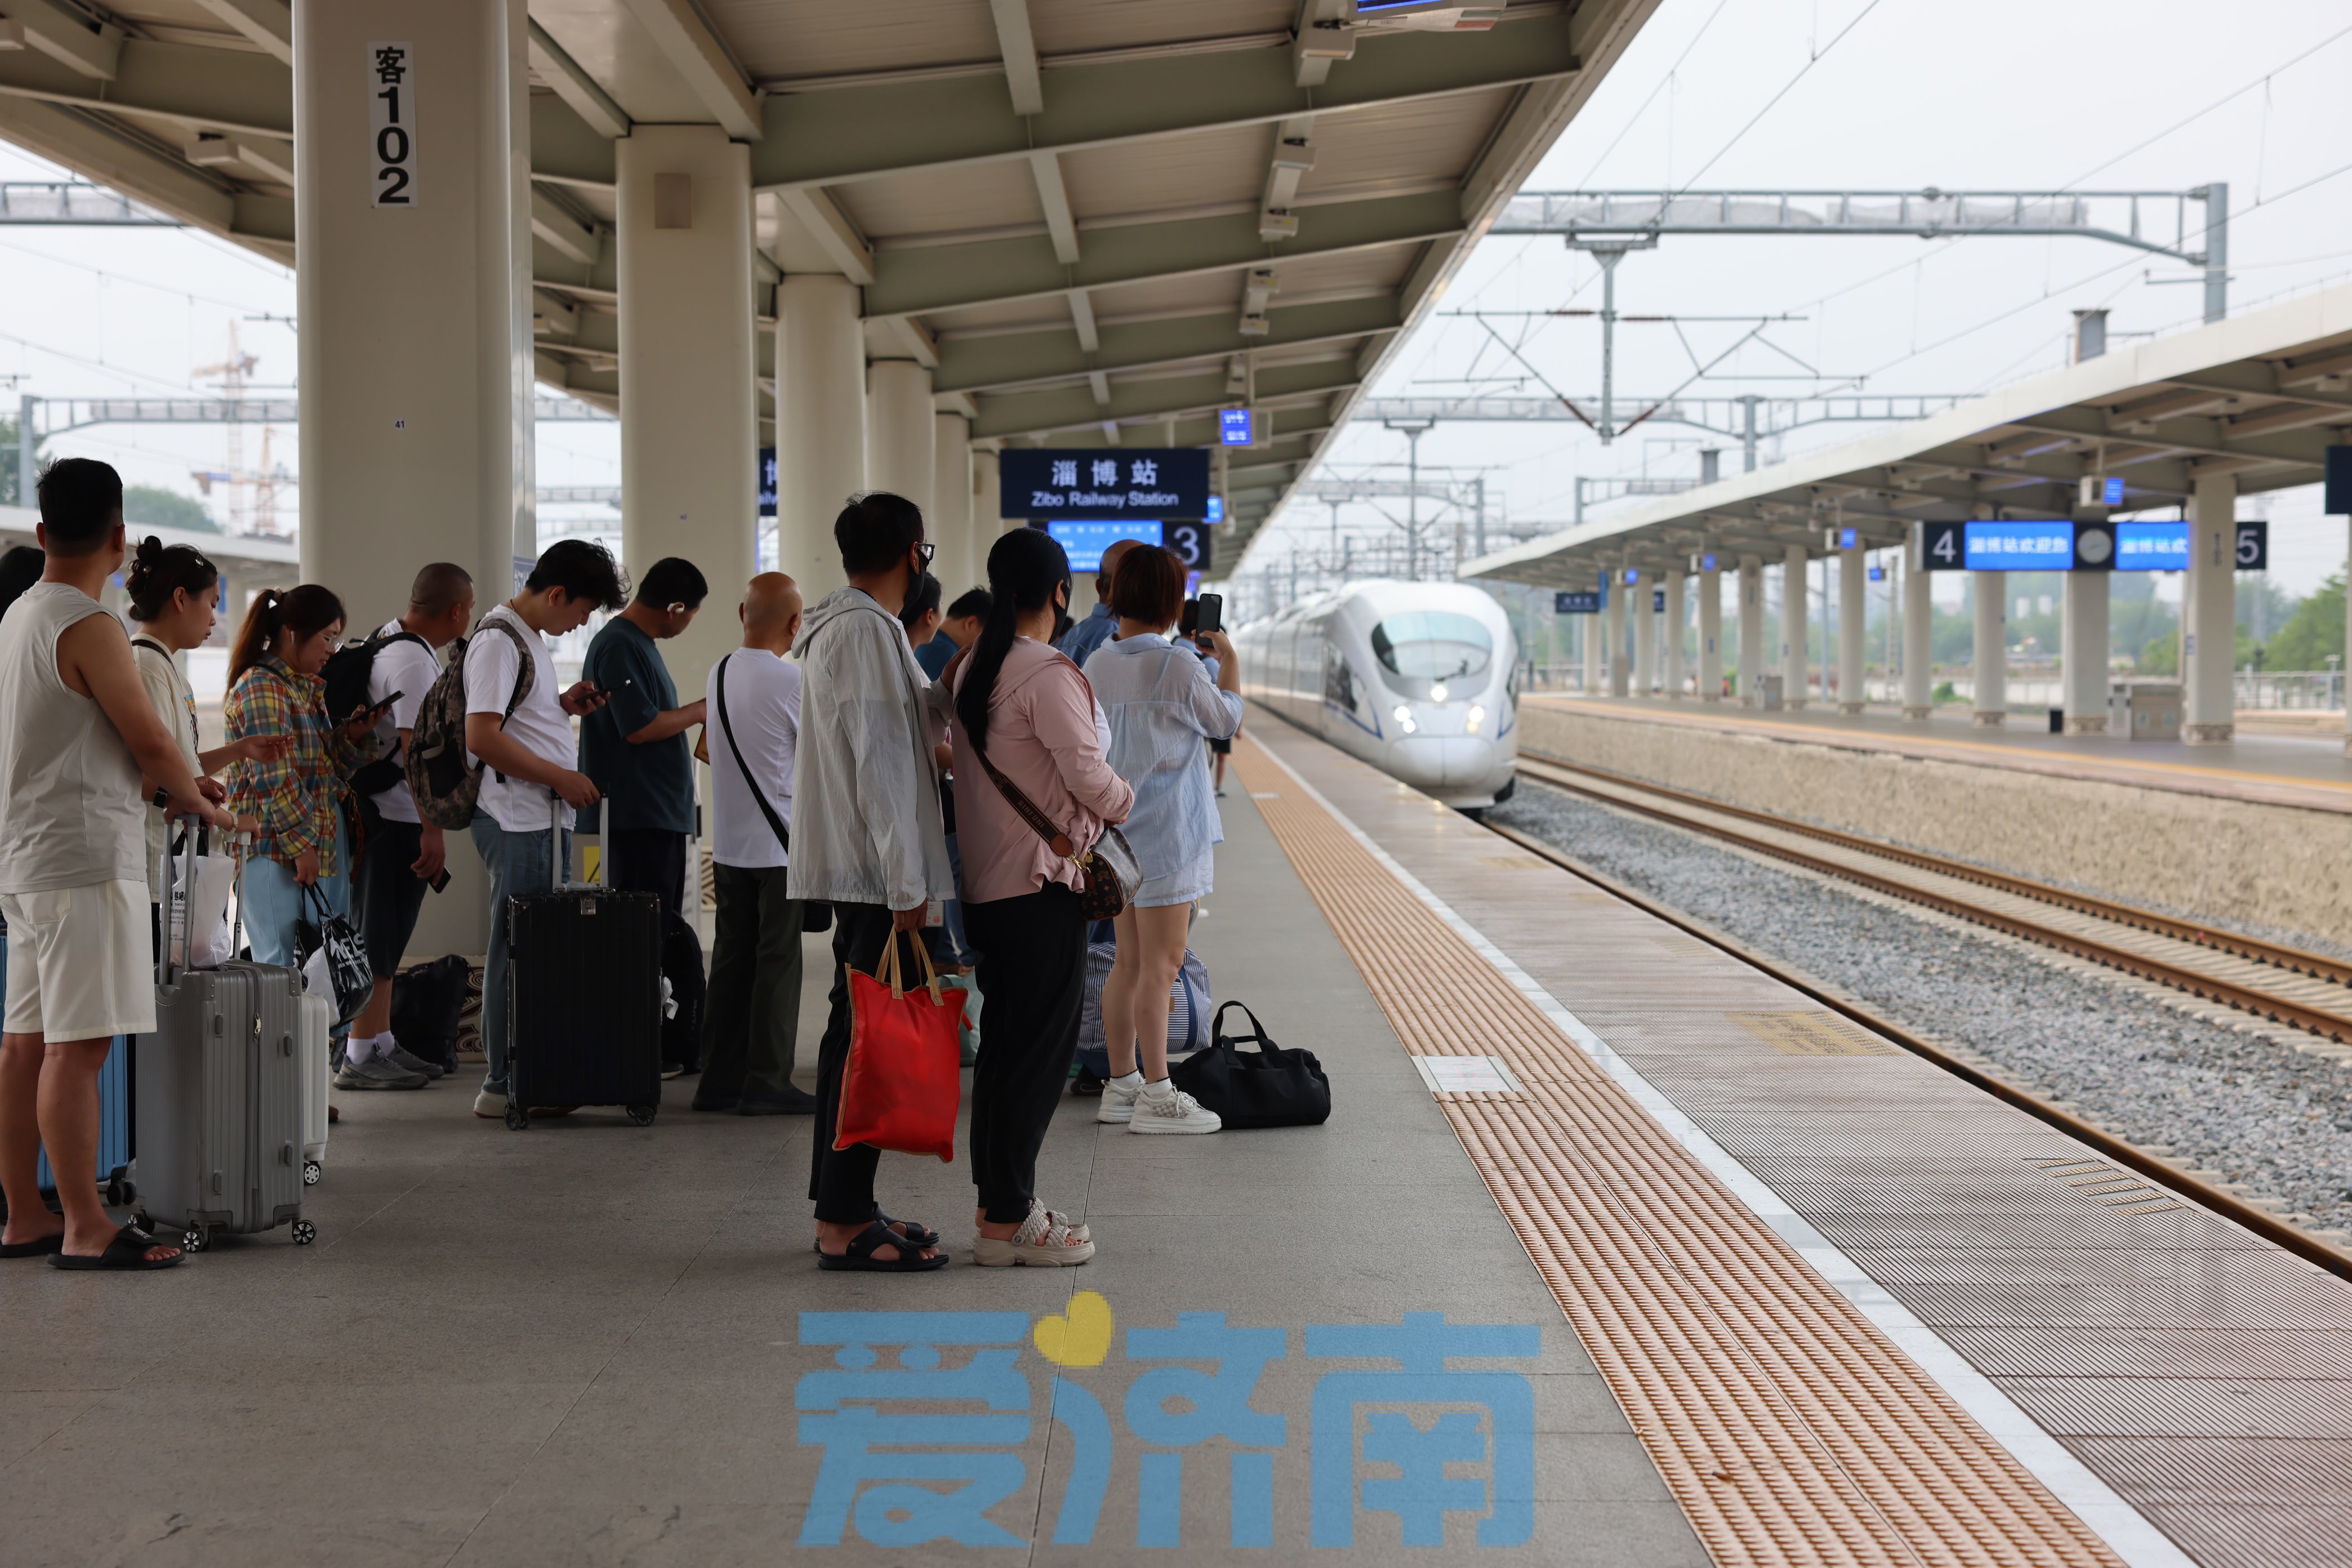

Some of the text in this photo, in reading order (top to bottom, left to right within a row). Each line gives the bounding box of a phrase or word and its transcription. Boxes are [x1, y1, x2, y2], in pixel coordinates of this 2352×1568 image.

[375, 46, 409, 203] 客102
[1052, 459, 1158, 486] 淄博站
[1031, 491, 1178, 509] Zibo Railway Station
[1173, 525, 1200, 565] 3
[1932, 529, 1956, 563] 4
[2237, 529, 2259, 563] 5
